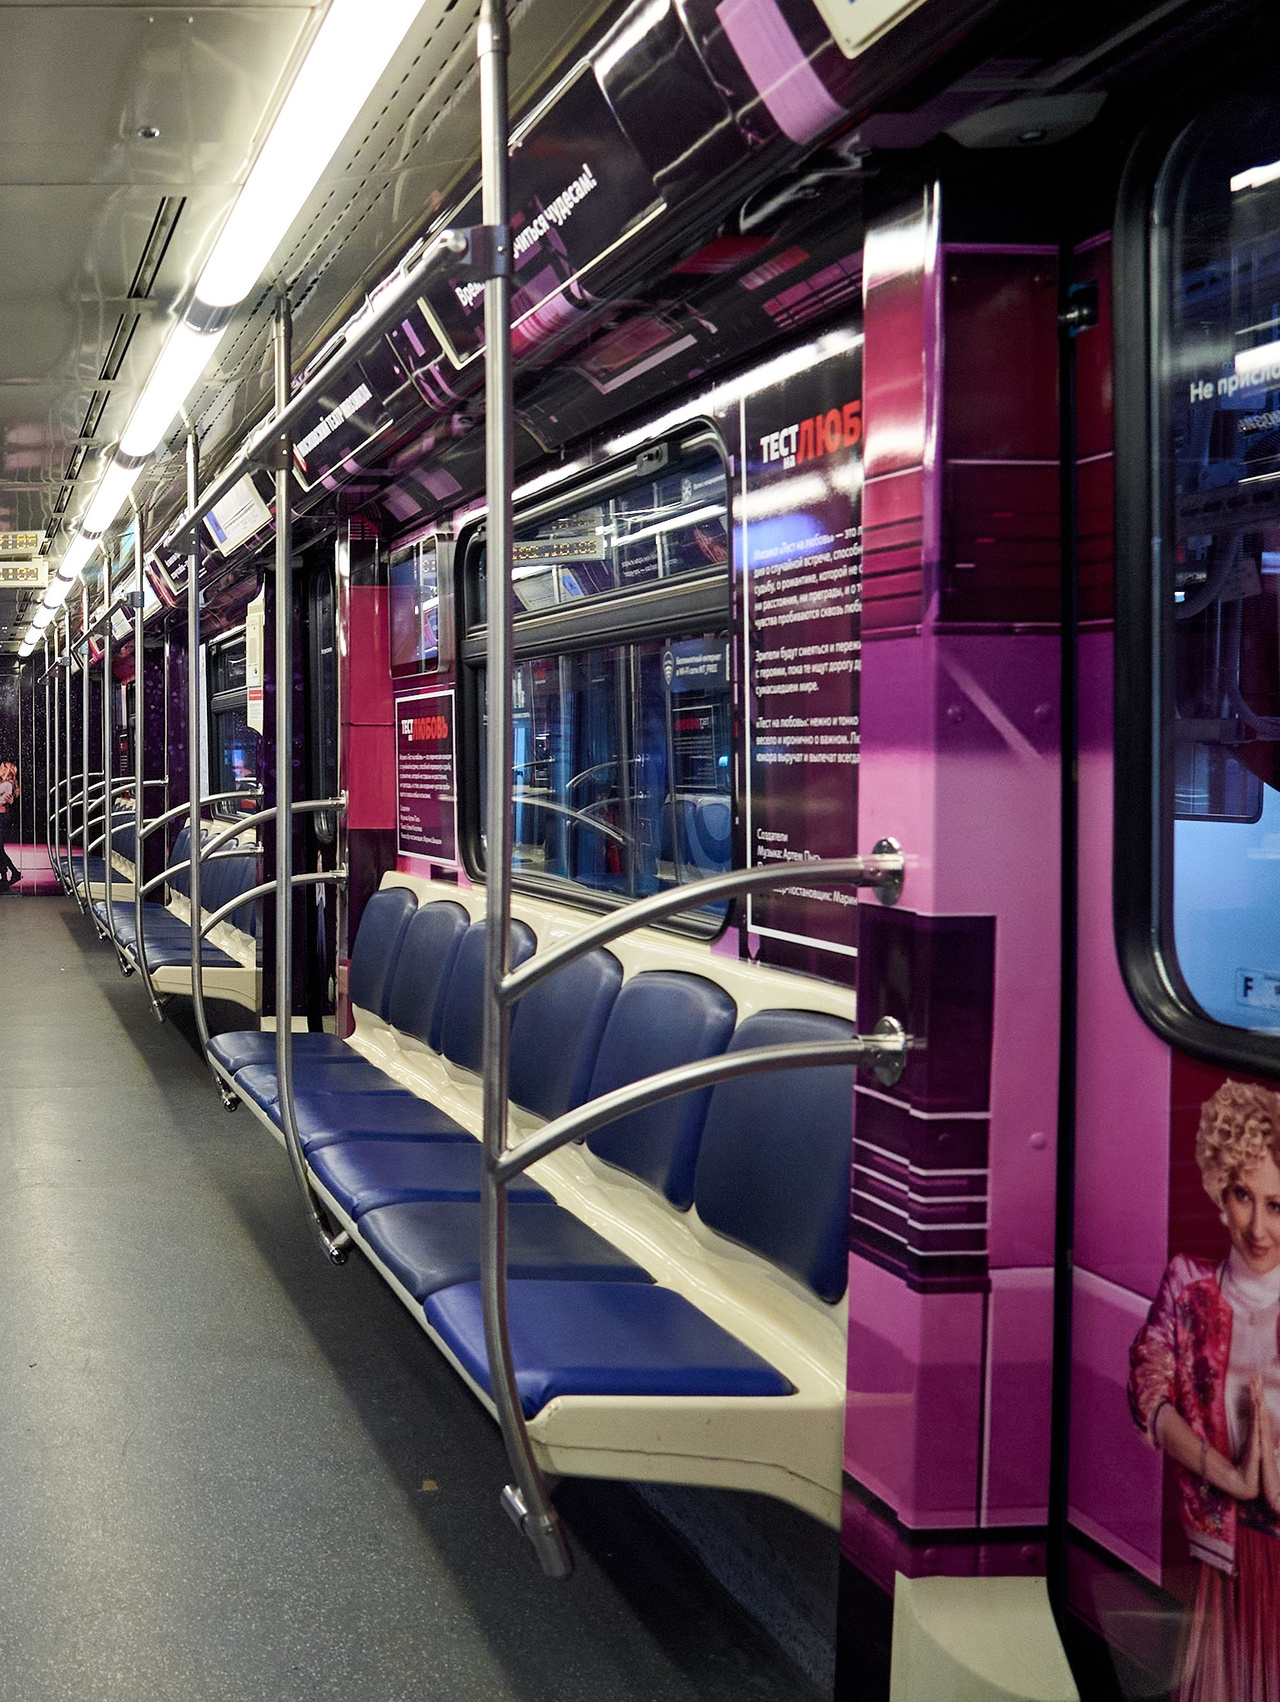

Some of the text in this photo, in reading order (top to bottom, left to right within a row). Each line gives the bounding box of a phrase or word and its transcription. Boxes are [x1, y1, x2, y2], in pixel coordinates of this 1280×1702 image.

[514, 213, 550, 259] читься
[543, 163, 597, 226] чудесам!
[1190, 381, 1214, 403] Не
[760, 400, 862, 464] ТЕСТ ЛЮБ
[783, 455, 796, 470] на
[844, 528, 856, 540] это
[766, 566, 770, 575] о
[776, 581, 781, 590] о
[819, 564, 848, 581] которой
[848, 565, 857, 575] не
[844, 585, 850, 594] и
[850, 584, 856, 594] о
[780, 646, 798, 661] будут
[830, 643, 835, 651] и
[755, 670, 760, 678] с
[787, 665, 803, 675] пока
[413, 715, 449, 740] ЛЮБОВЬ
[832, 717, 838, 726] и
[838, 716, 859, 726] тонко
[756, 736, 777, 745] весело
[777, 736, 782, 745] и
[814, 735, 819, 745] о
[1243, 976, 1253, 997] F
